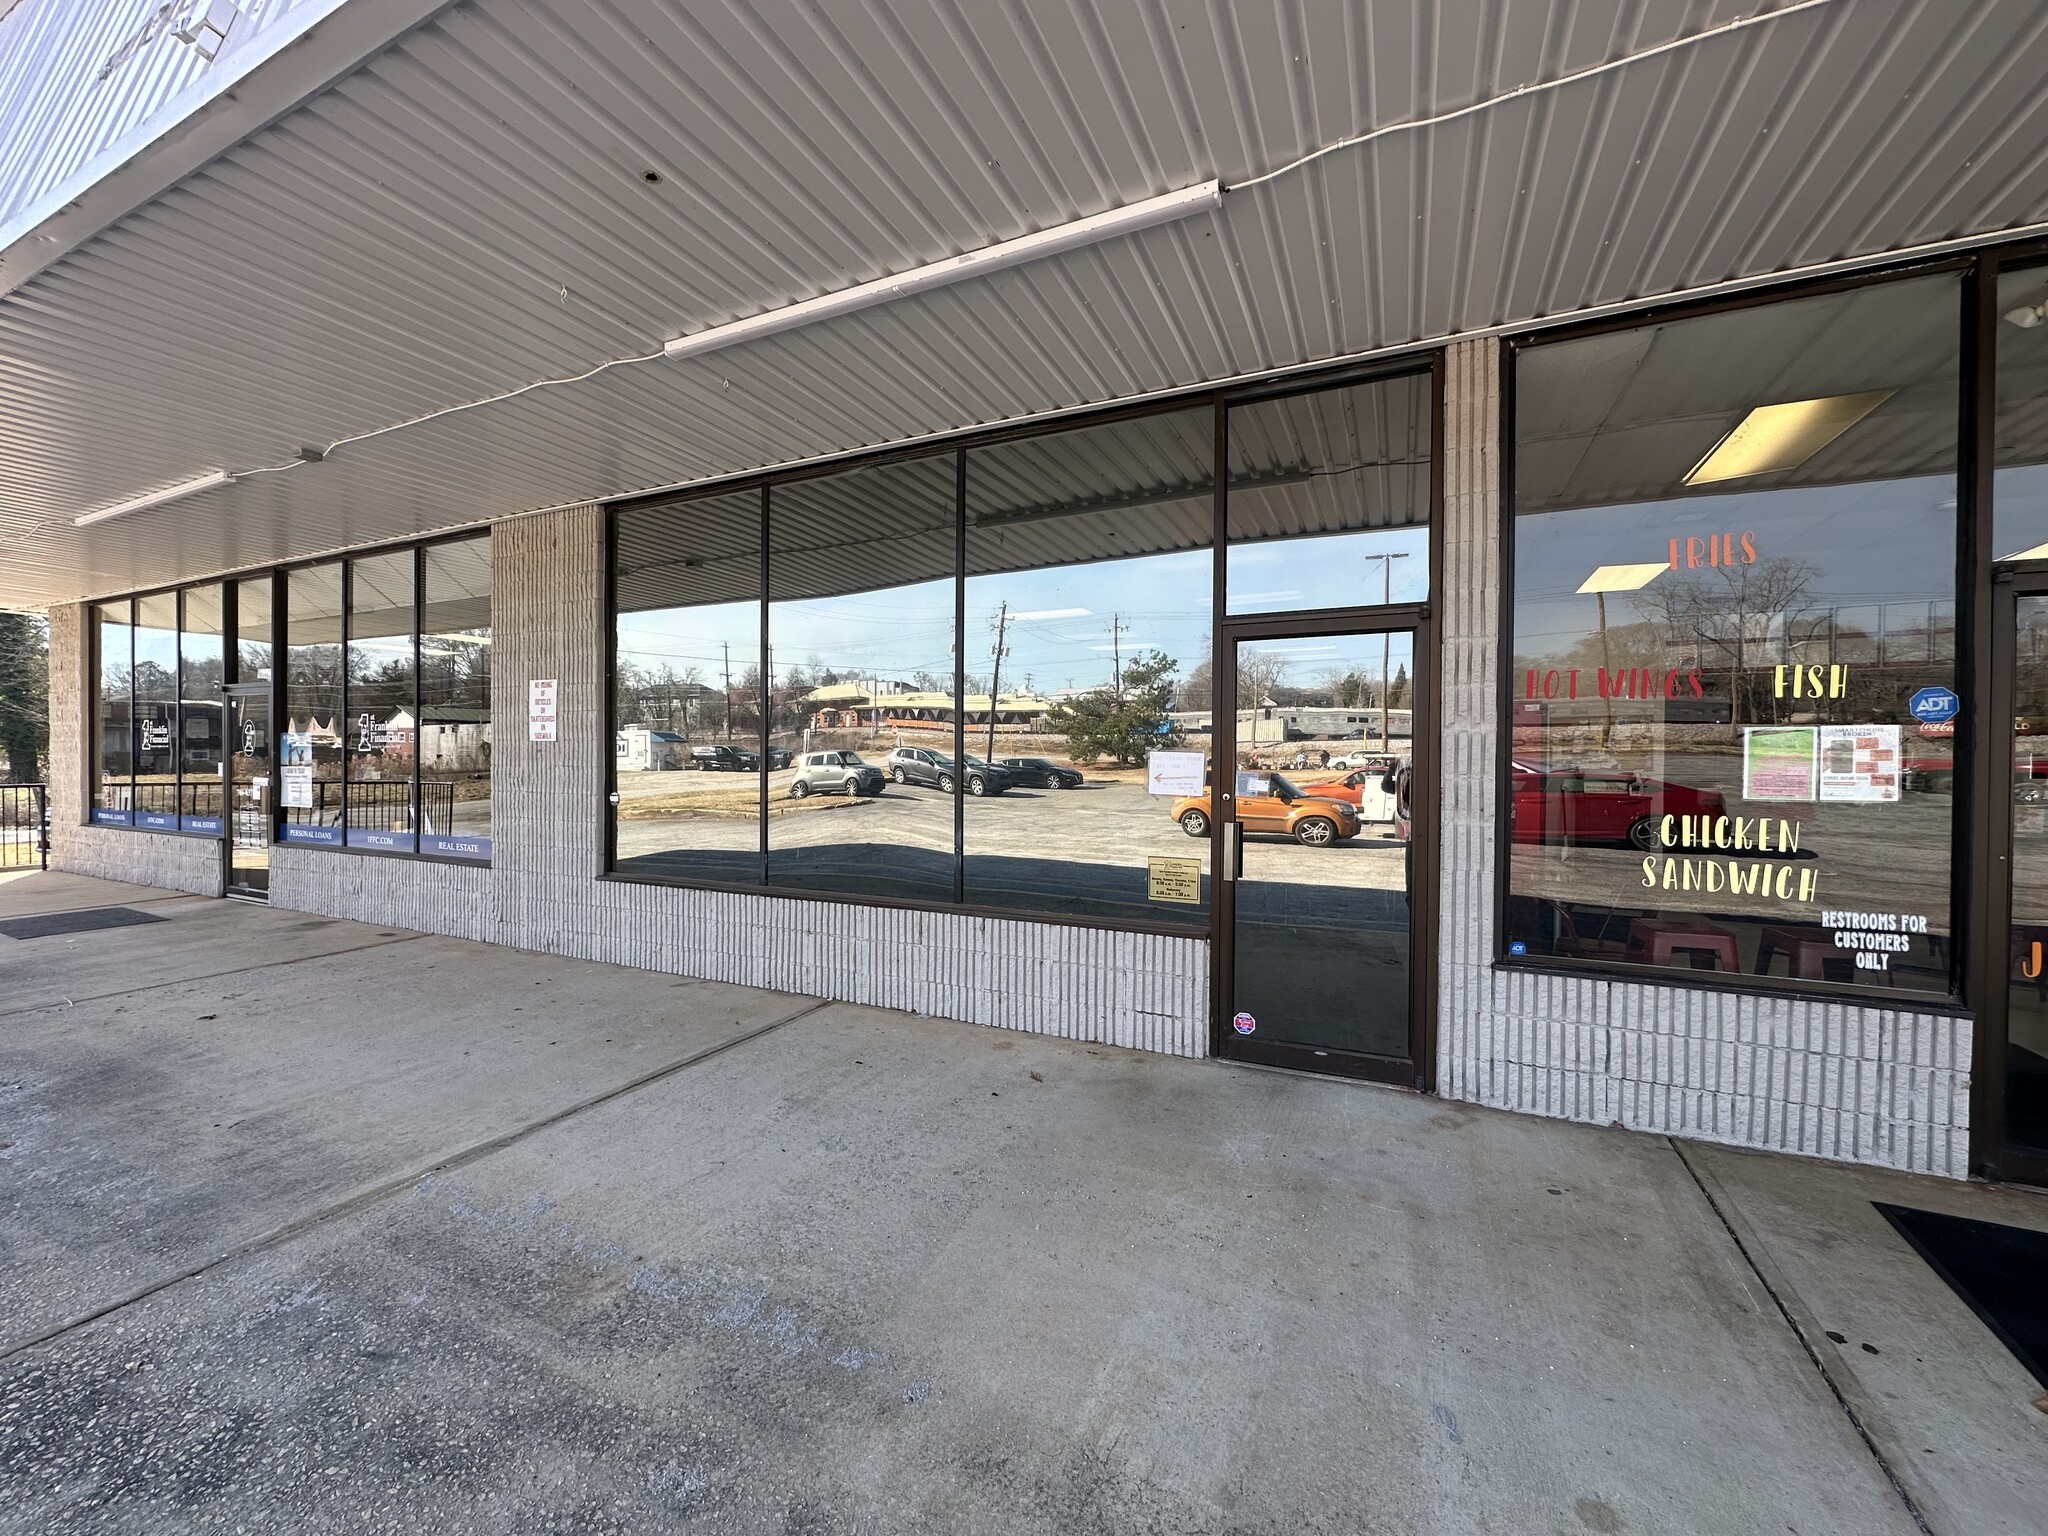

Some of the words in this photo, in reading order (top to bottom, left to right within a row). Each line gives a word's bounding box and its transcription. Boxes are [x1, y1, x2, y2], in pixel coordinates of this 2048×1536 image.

[1669, 531, 1756, 571] FRIES
[1526, 669, 1582, 700] HOT
[1597, 668, 1704, 700] WINGS
[1775, 664, 1848, 699] FISH
[1915, 696, 1953, 711] ADT
[192, 820, 202, 828] REAL
[289, 829, 314, 838] PERSONAL
[315, 832, 332, 840] LOANS
[1660, 814, 1800, 853] CHICKEN
[367, 835, 394, 846] 1FFC.COM
[438, 841, 455, 851] REAL
[456, 843, 479, 853] ESTATE
[1642, 856, 1818, 902] SANDWICH
[1821, 911, 1897, 929] RESTROOMS
[1901, 914, 1927, 933] FOR
[1834, 931, 1910, 952] CUSTOMERS
[1855, 951, 1889, 970] ONLY
[2022, 941, 2043, 978] J
